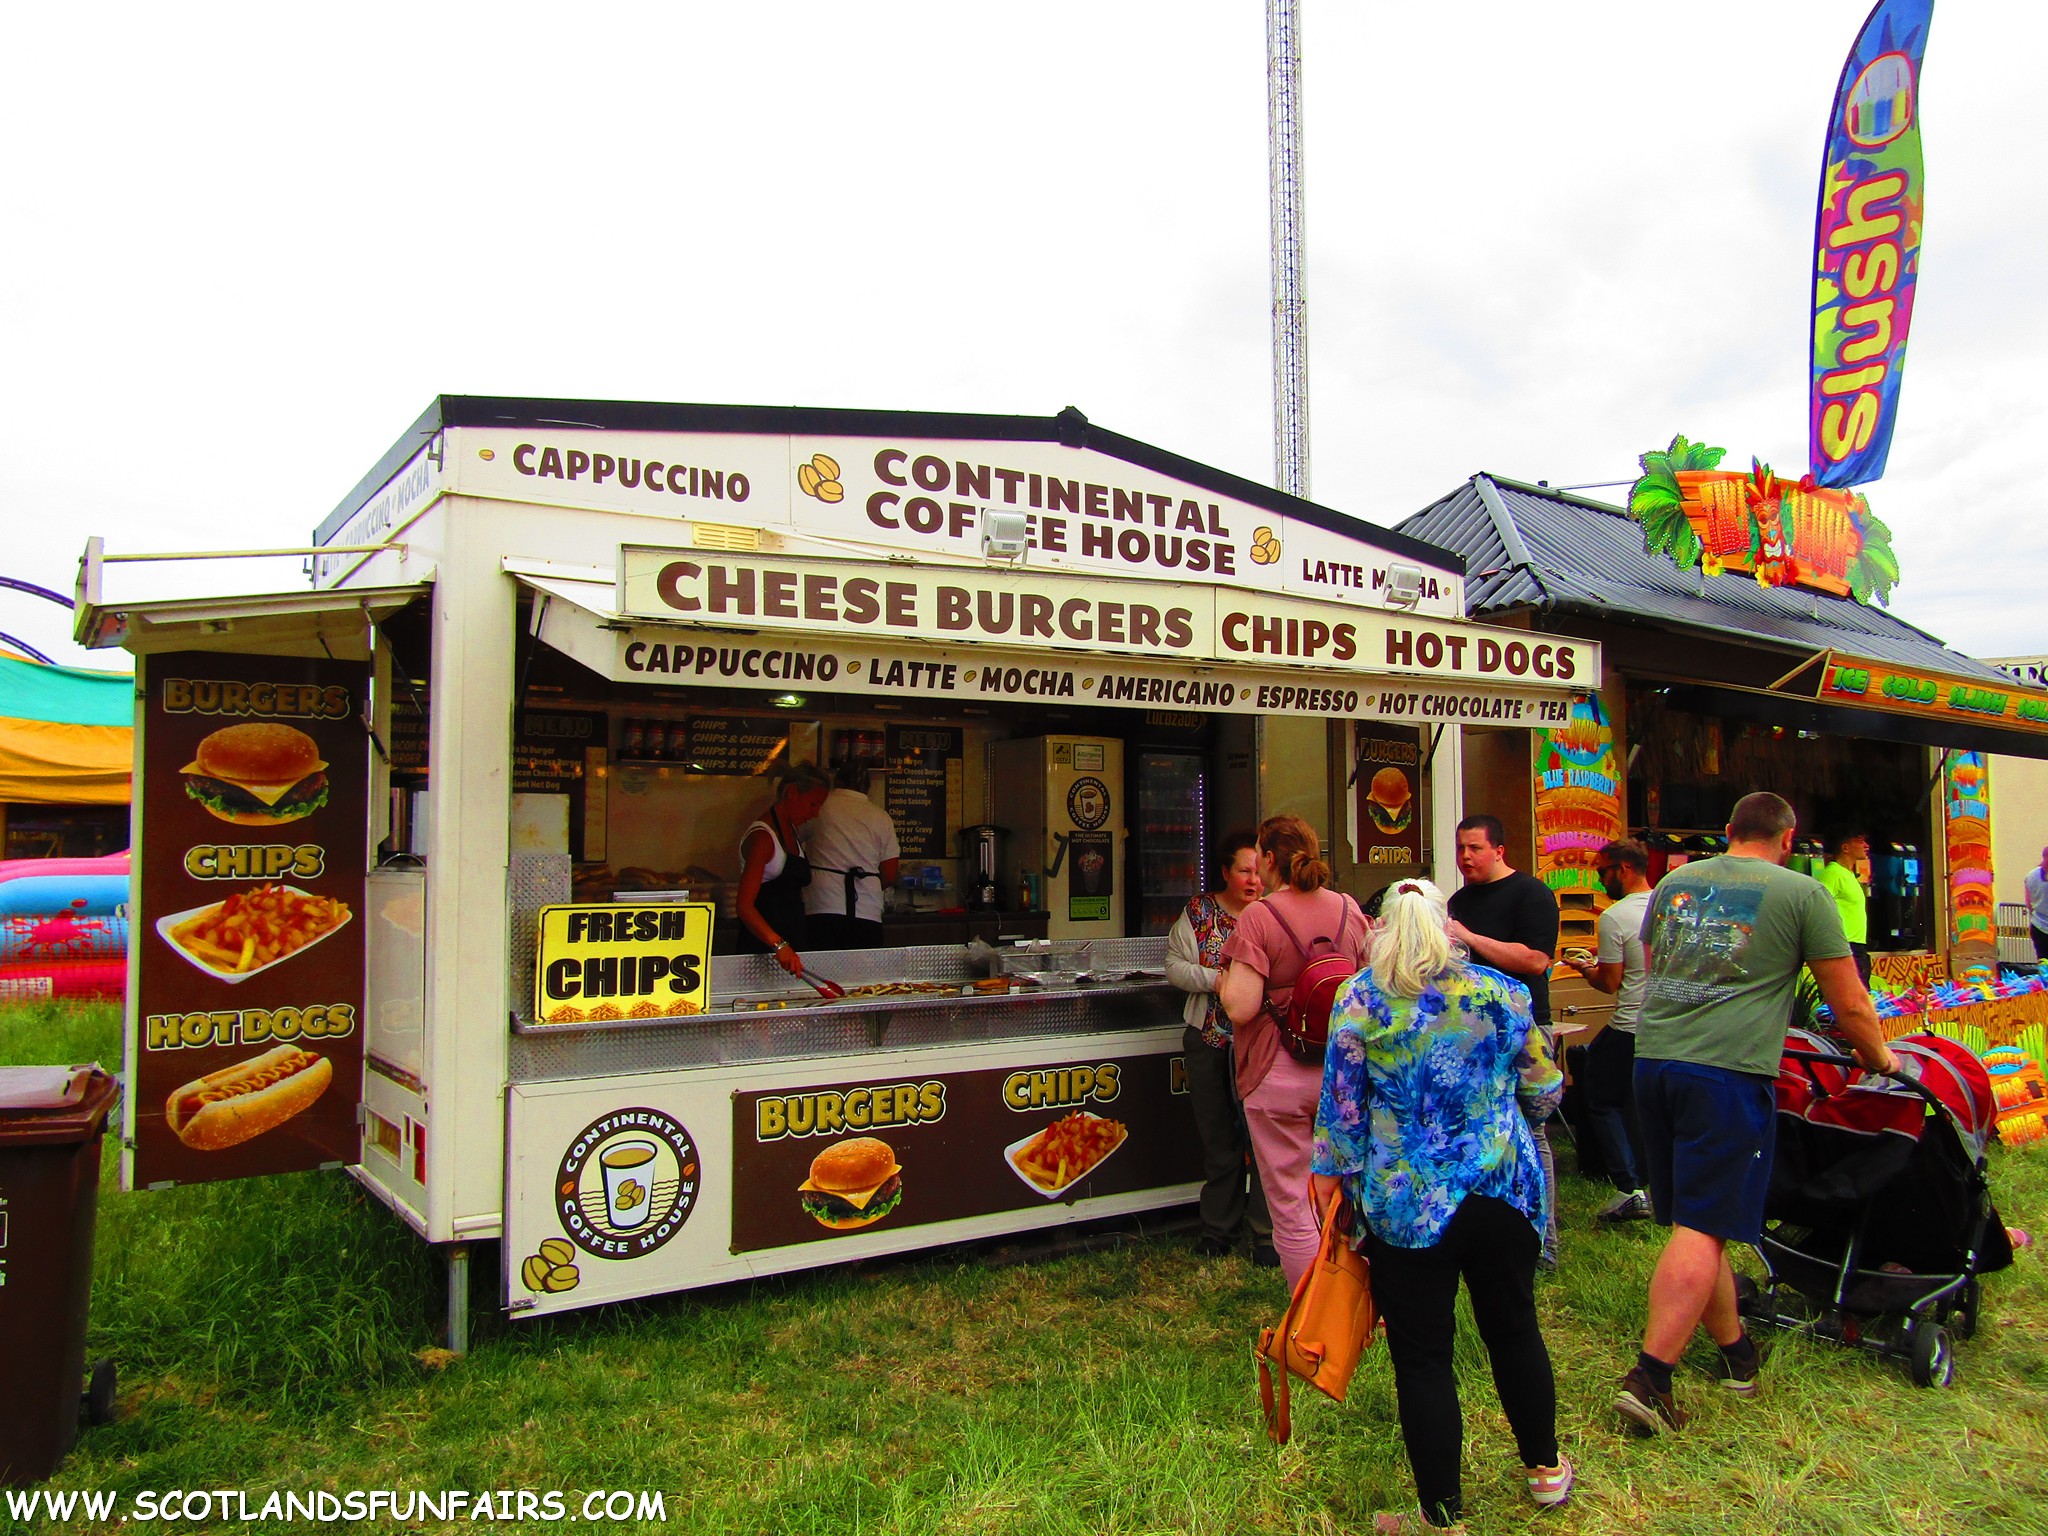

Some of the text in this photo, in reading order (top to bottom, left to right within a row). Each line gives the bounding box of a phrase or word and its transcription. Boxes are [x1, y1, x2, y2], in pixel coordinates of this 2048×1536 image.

[1821, 172, 1907, 463] Slush
[397, 462, 429, 513] MOCHA
[513, 444, 750, 502] CAPPUCCINO
[874, 449, 1230, 537] CONTINENTAL
[866, 491, 1236, 576] COFEE HOUSE
[1303, 558, 1439, 599] LATTE MHA
[657, 561, 1193, 647] CHEESE BURGERS
[1222, 612, 1575, 679] CHIPS HOT DOGS
[164, 679, 349, 719] BURGERS
[624, 642, 1567, 721] CAPPUCCINO LATTE MOCHA AMERICANO ESPRESSO HOT CHOCOLATE TEA
[1832, 666, 1870, 694] ICE
[1882, 675, 1938, 703] COLD
[1948, 686, 2008, 715] SLUSH
[692, 720, 728, 729] CHIPS
[692, 733, 726, 743] CHIPS
[728, 735, 738, 743] &
[692, 746, 725, 755] CHIPS
[728, 747, 738, 756] &
[728, 761, 738, 769] &
[546, 781, 560, 791] Dog
[925, 769, 944, 777] Burger
[926, 779, 944, 787] Burger
[1069, 779, 1107, 798] CONTINENTAL
[1542, 768, 1616, 797] BLUE RASPBERRY
[889, 808, 905, 816] Chips
[908, 798, 932, 806] Sausage
[1069, 805, 1109, 829] COFFEE HOUSE
[915, 827, 933, 835] Gravy
[1543, 808, 1614, 836] STRAWBERRY
[185, 845, 324, 880] CHIPS
[1369, 846, 1412, 864] CHIPS
[1544, 868, 1578, 891] LEMON
[1582, 868, 1588, 888] &
[568, 911, 685, 943] FRESH
[546, 954, 700, 1000] CHIPS
[147, 1004, 355, 1051] HOT DOGS
[1003, 1063, 1121, 1112] CHIPS
[757, 1081, 946, 1142] BURGERS
[566, 1113, 691, 1172] CONTINENTAL
[564, 1181, 693, 1252] COFFEE HOUSE
